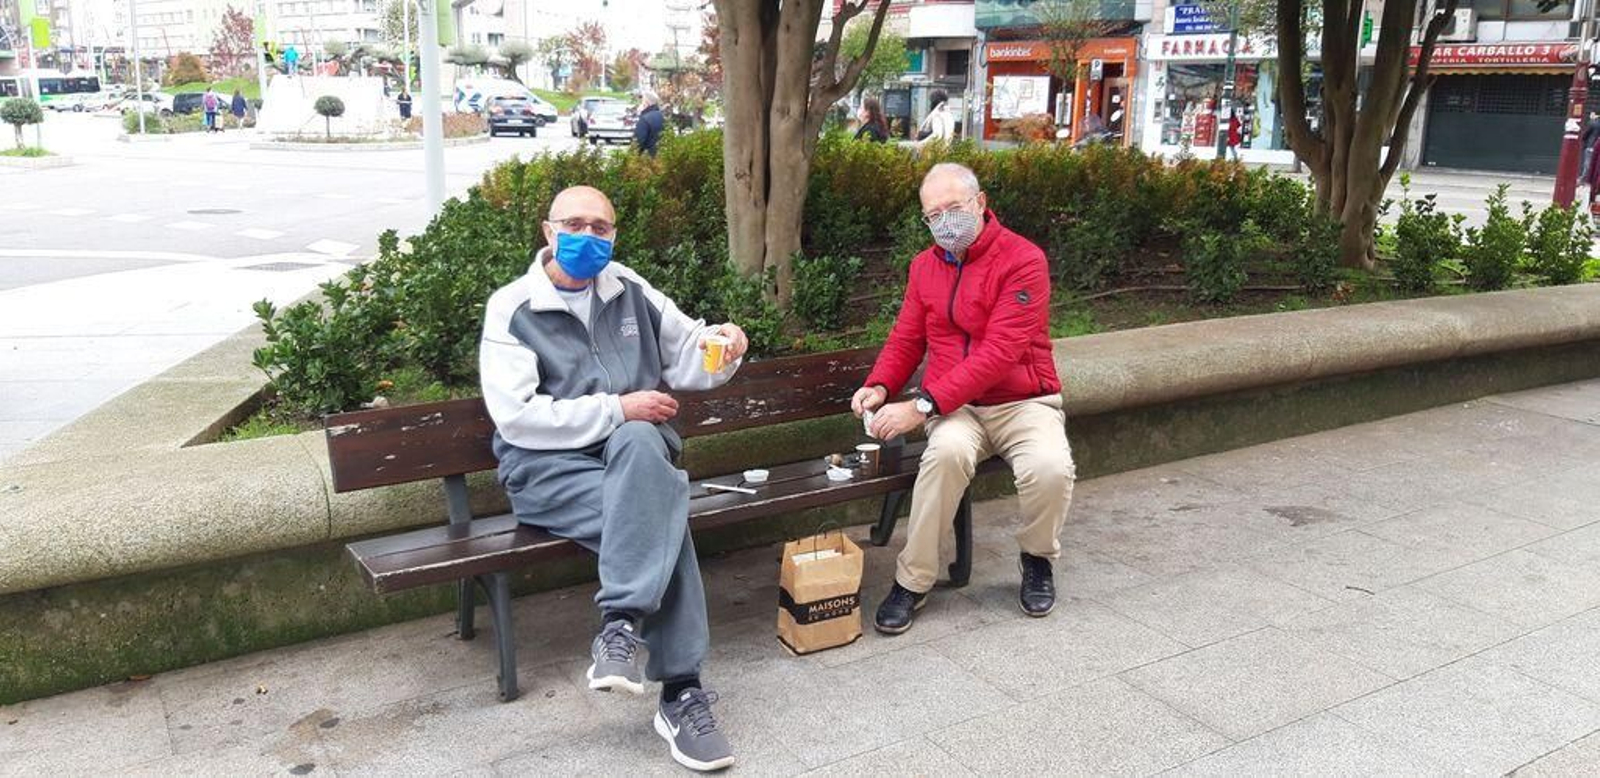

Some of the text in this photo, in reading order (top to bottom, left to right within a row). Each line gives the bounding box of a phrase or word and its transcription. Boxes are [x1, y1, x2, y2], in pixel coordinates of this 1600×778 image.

[1162, 40, 1252, 55] FARMACA
[1432, 46, 1452, 57] AR
[1457, 46, 1536, 57] CARBALLO
[1541, 46, 1549, 56] 3
[808, 596, 856, 613] MAISONS
